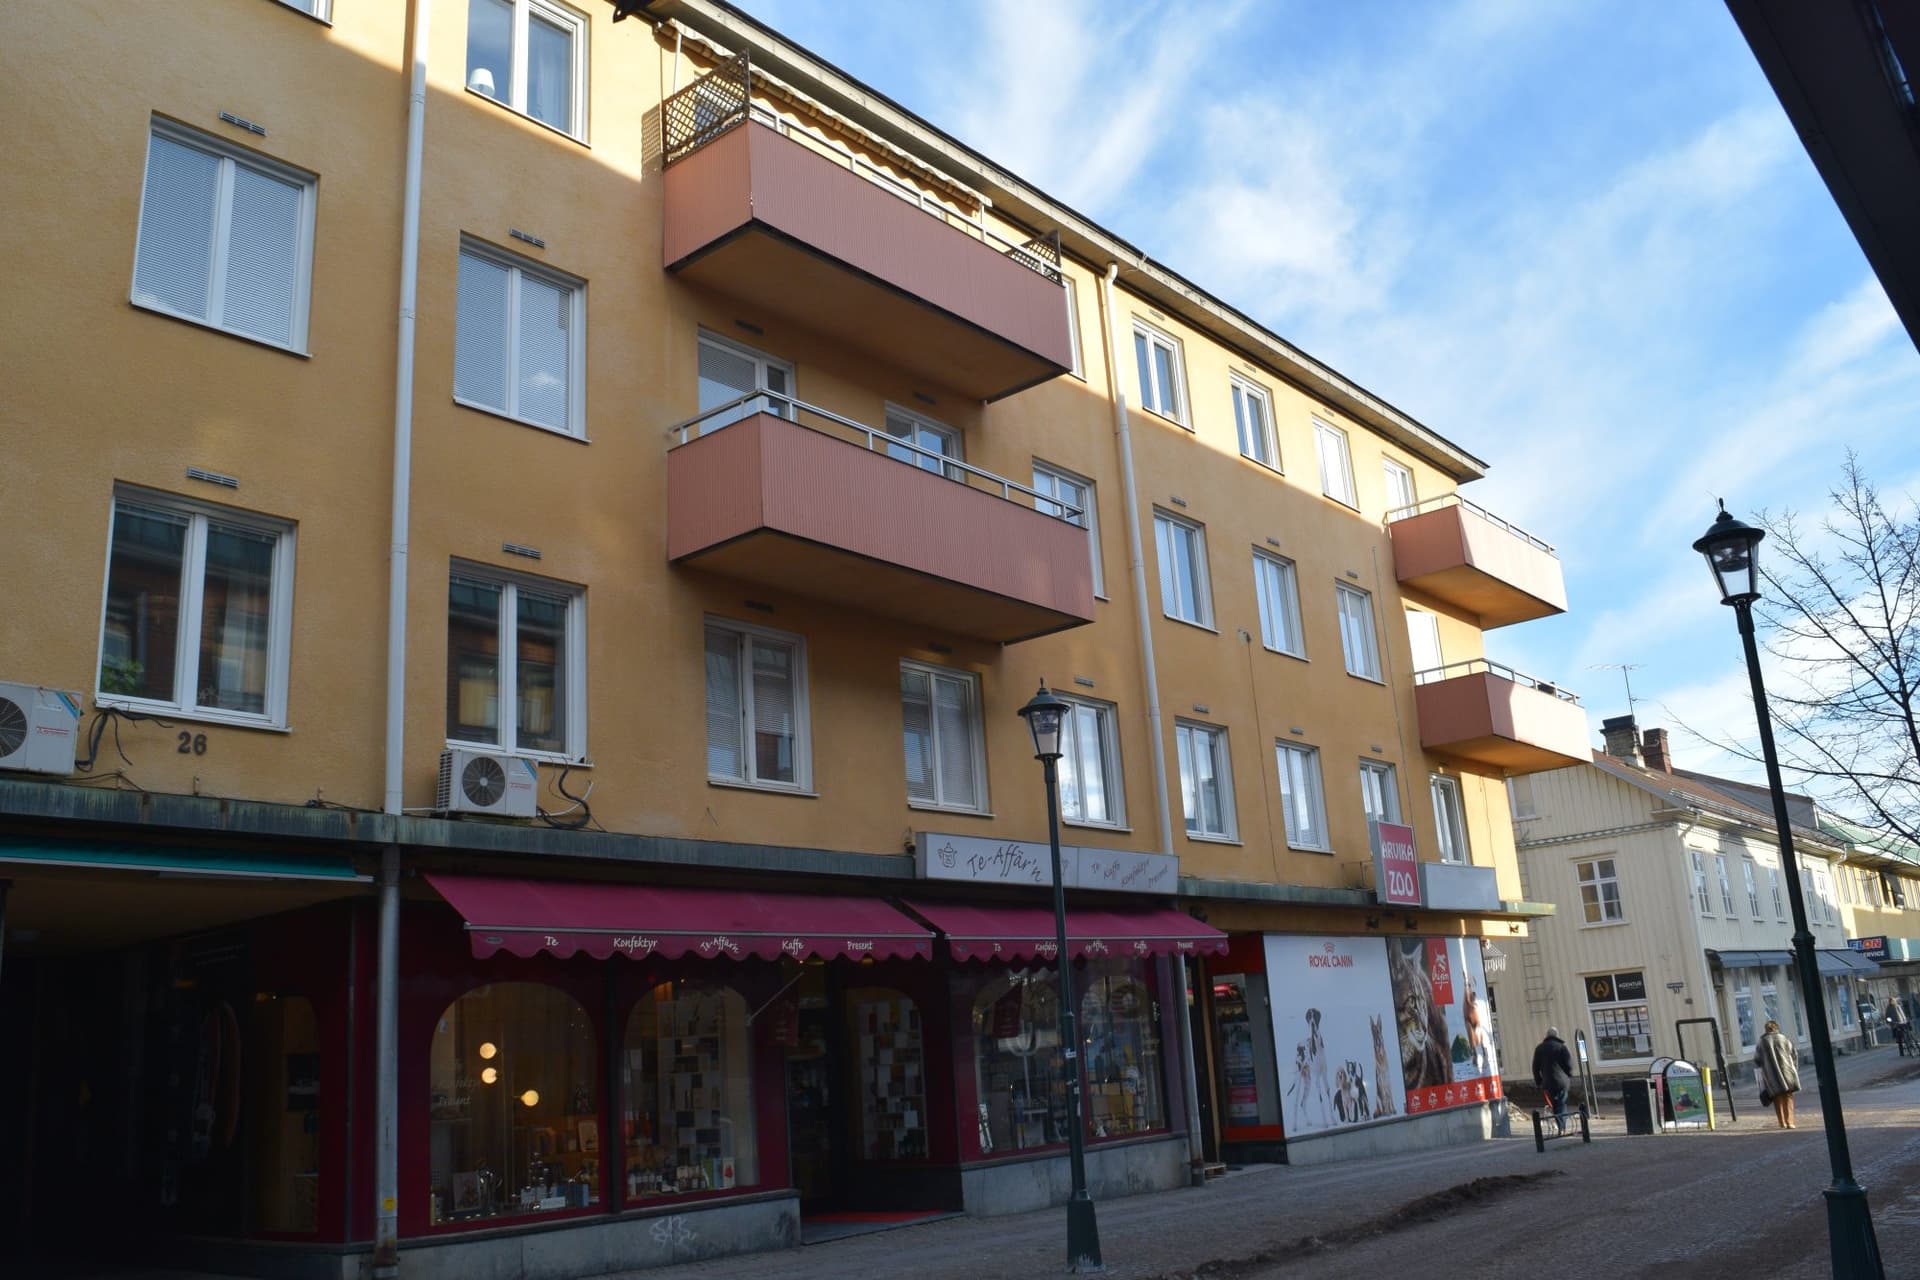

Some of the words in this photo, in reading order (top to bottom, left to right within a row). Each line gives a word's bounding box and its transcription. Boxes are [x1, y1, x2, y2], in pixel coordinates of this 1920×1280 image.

[178, 730, 208, 756] 26
[1381, 841, 1414, 862] ARVIKA
[1388, 870, 1414, 897] ZOO
[544, 935, 559, 946] Te
[613, 937, 658, 953] Konfektyr
[781, 938, 804, 955] Kaffe
[847, 940, 873, 950] Present
[1308, 955, 1331, 968] ROYAL
[1331, 955, 1354, 968] CANIN
